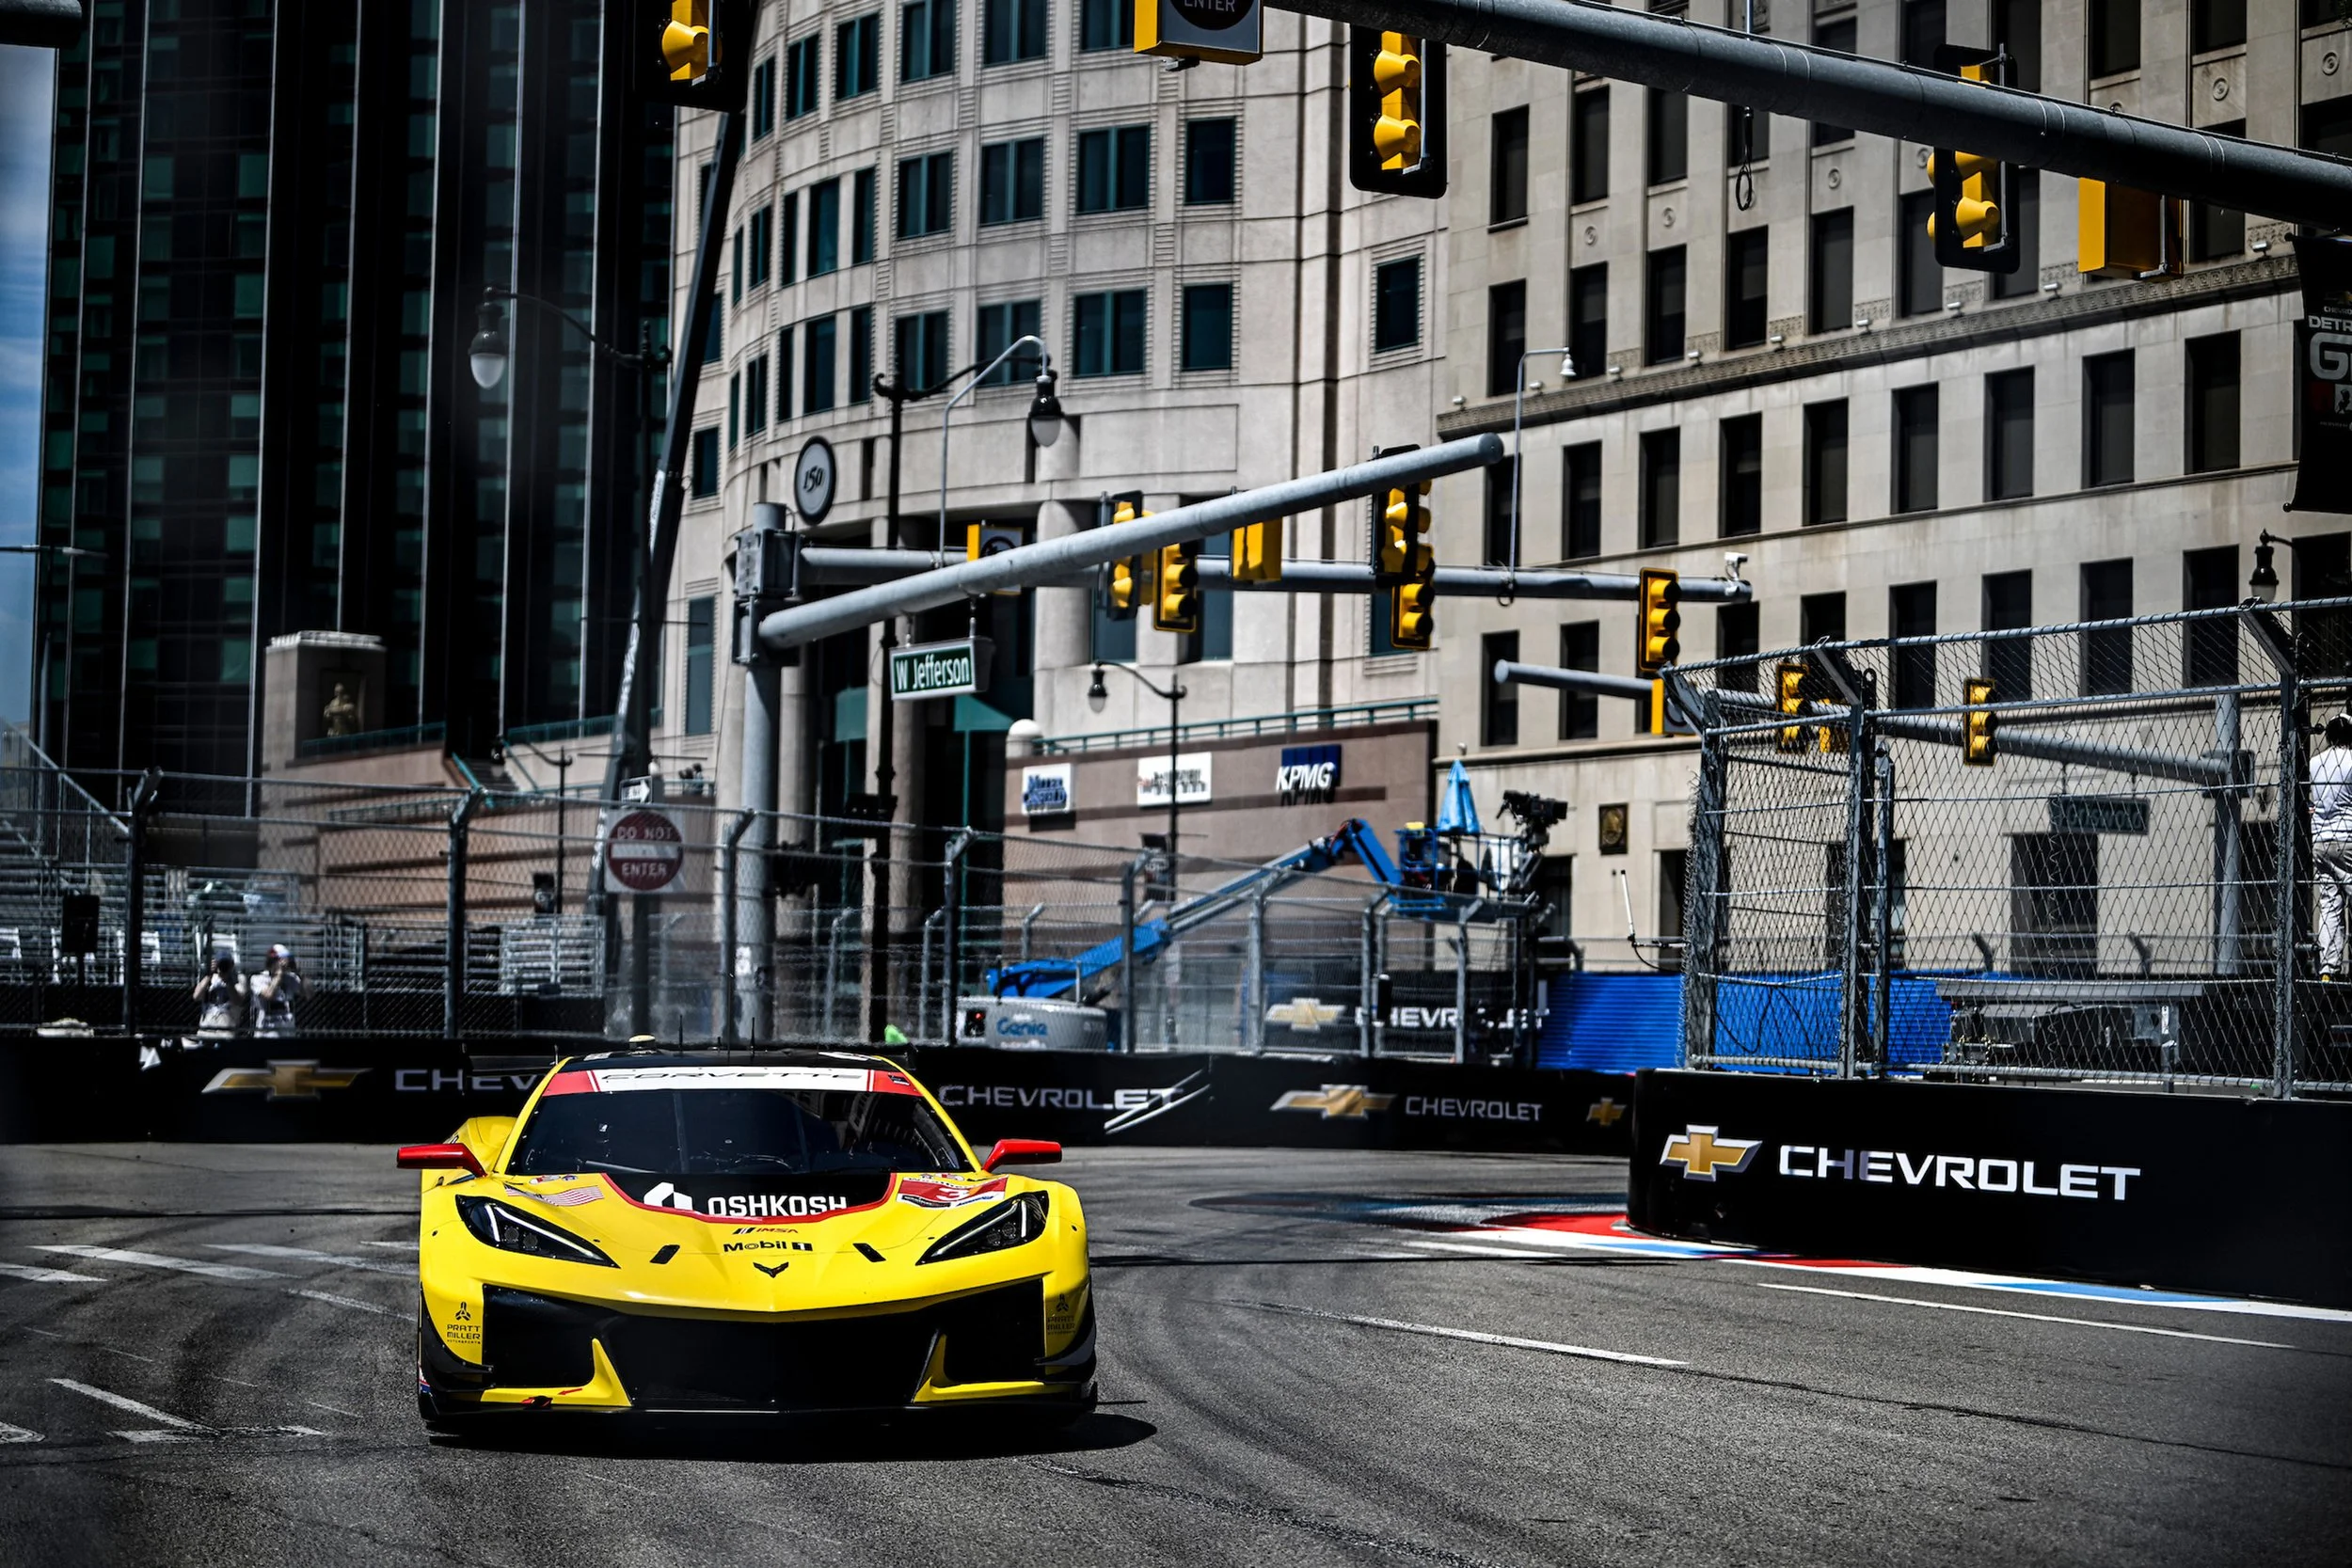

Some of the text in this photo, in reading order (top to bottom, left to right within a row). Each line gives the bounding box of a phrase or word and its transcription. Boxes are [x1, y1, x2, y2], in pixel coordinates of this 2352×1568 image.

[2310, 332, 2352, 381] G
[803, 465, 824, 493] 150
[896, 654, 970, 690] W Jefferson
[1276, 762, 1335, 792] KPMG
[616, 826, 673, 839] DO NOT
[621, 862, 668, 877] ENTER
[996, 1017, 1047, 1037] Genie
[938, 1085, 1183, 1111] CHEVROLET
[1405, 1096, 1543, 1121] CHEVROLET
[1778, 1144, 2141, 1200] CHEVROLET
[707, 1195, 848, 1217] OSHKOSH
[935, 1187, 969, 1202] 3
[723, 1241, 787, 1252] Mobil
